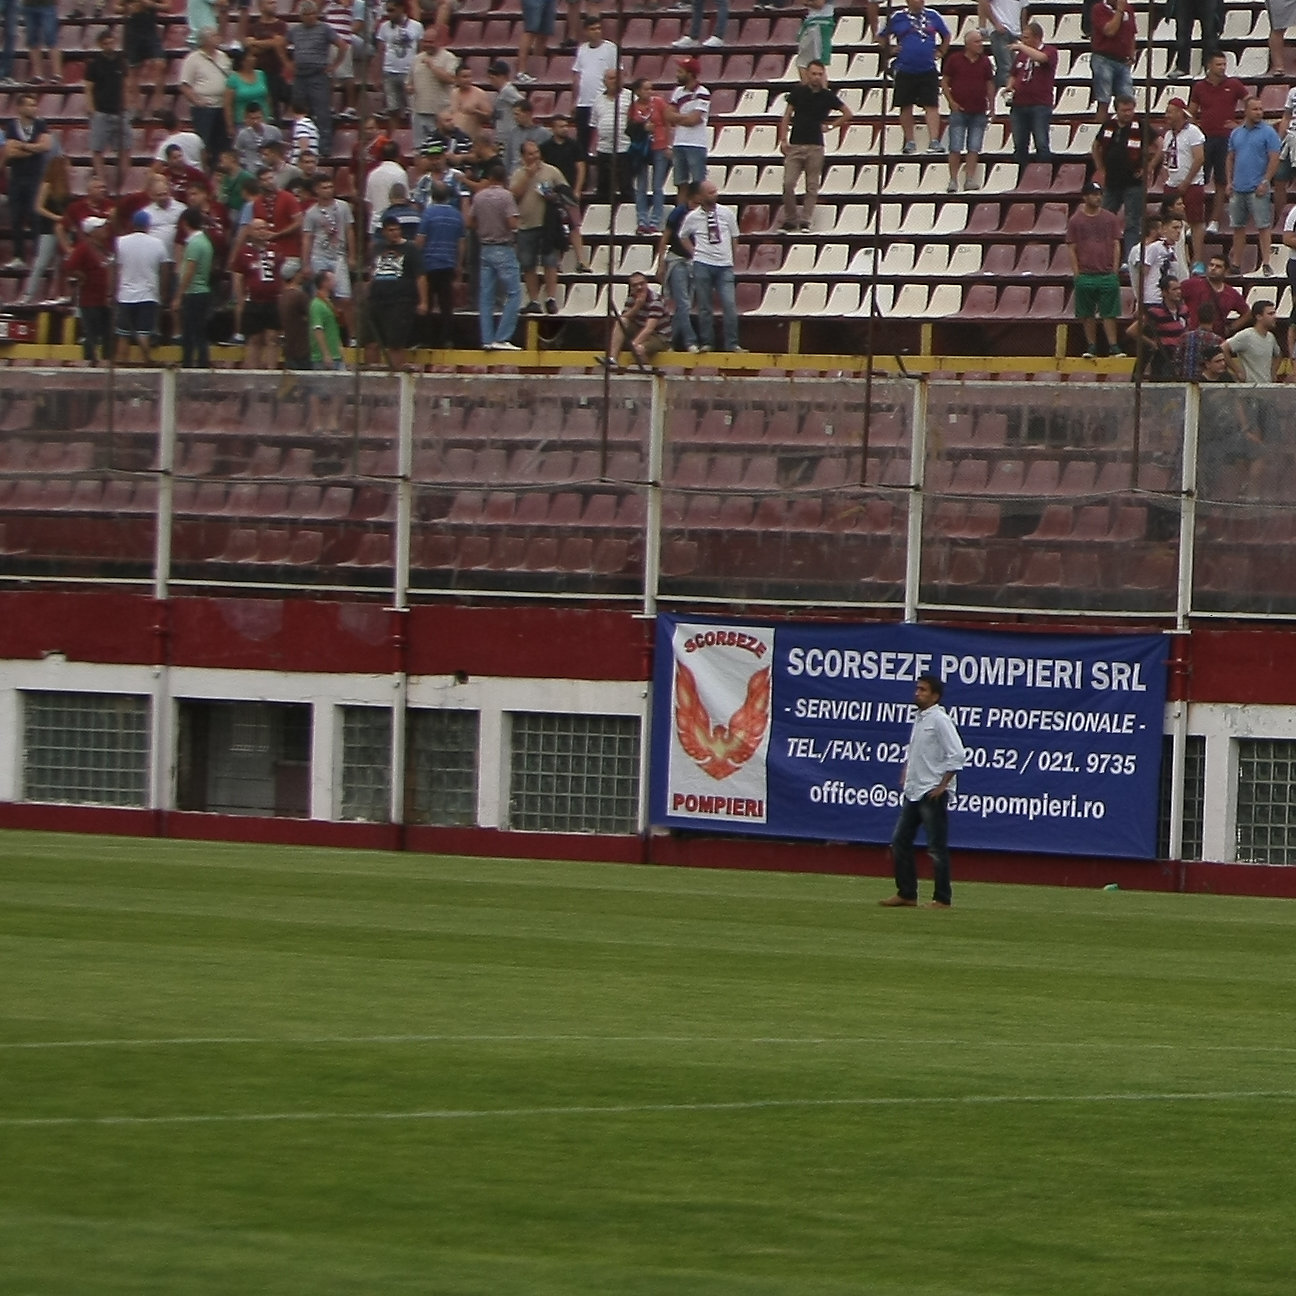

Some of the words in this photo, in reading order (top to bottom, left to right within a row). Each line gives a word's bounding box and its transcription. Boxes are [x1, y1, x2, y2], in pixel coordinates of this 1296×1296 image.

[684, 631, 768, 659] SCORSEZE
[940, 654, 1083, 690] POMPIERI
[1091, 661, 1147, 692] SRL
[795, 698, 872, 722] SERVICII
[987, 707, 1136, 734] PROFESIONALE
[787, 737, 871, 763] TEL./FAX:
[1038, 750, 1080, 773] 021.
[1086, 753, 1137, 775] 9735
[673, 793, 764, 818] POMPIERI
